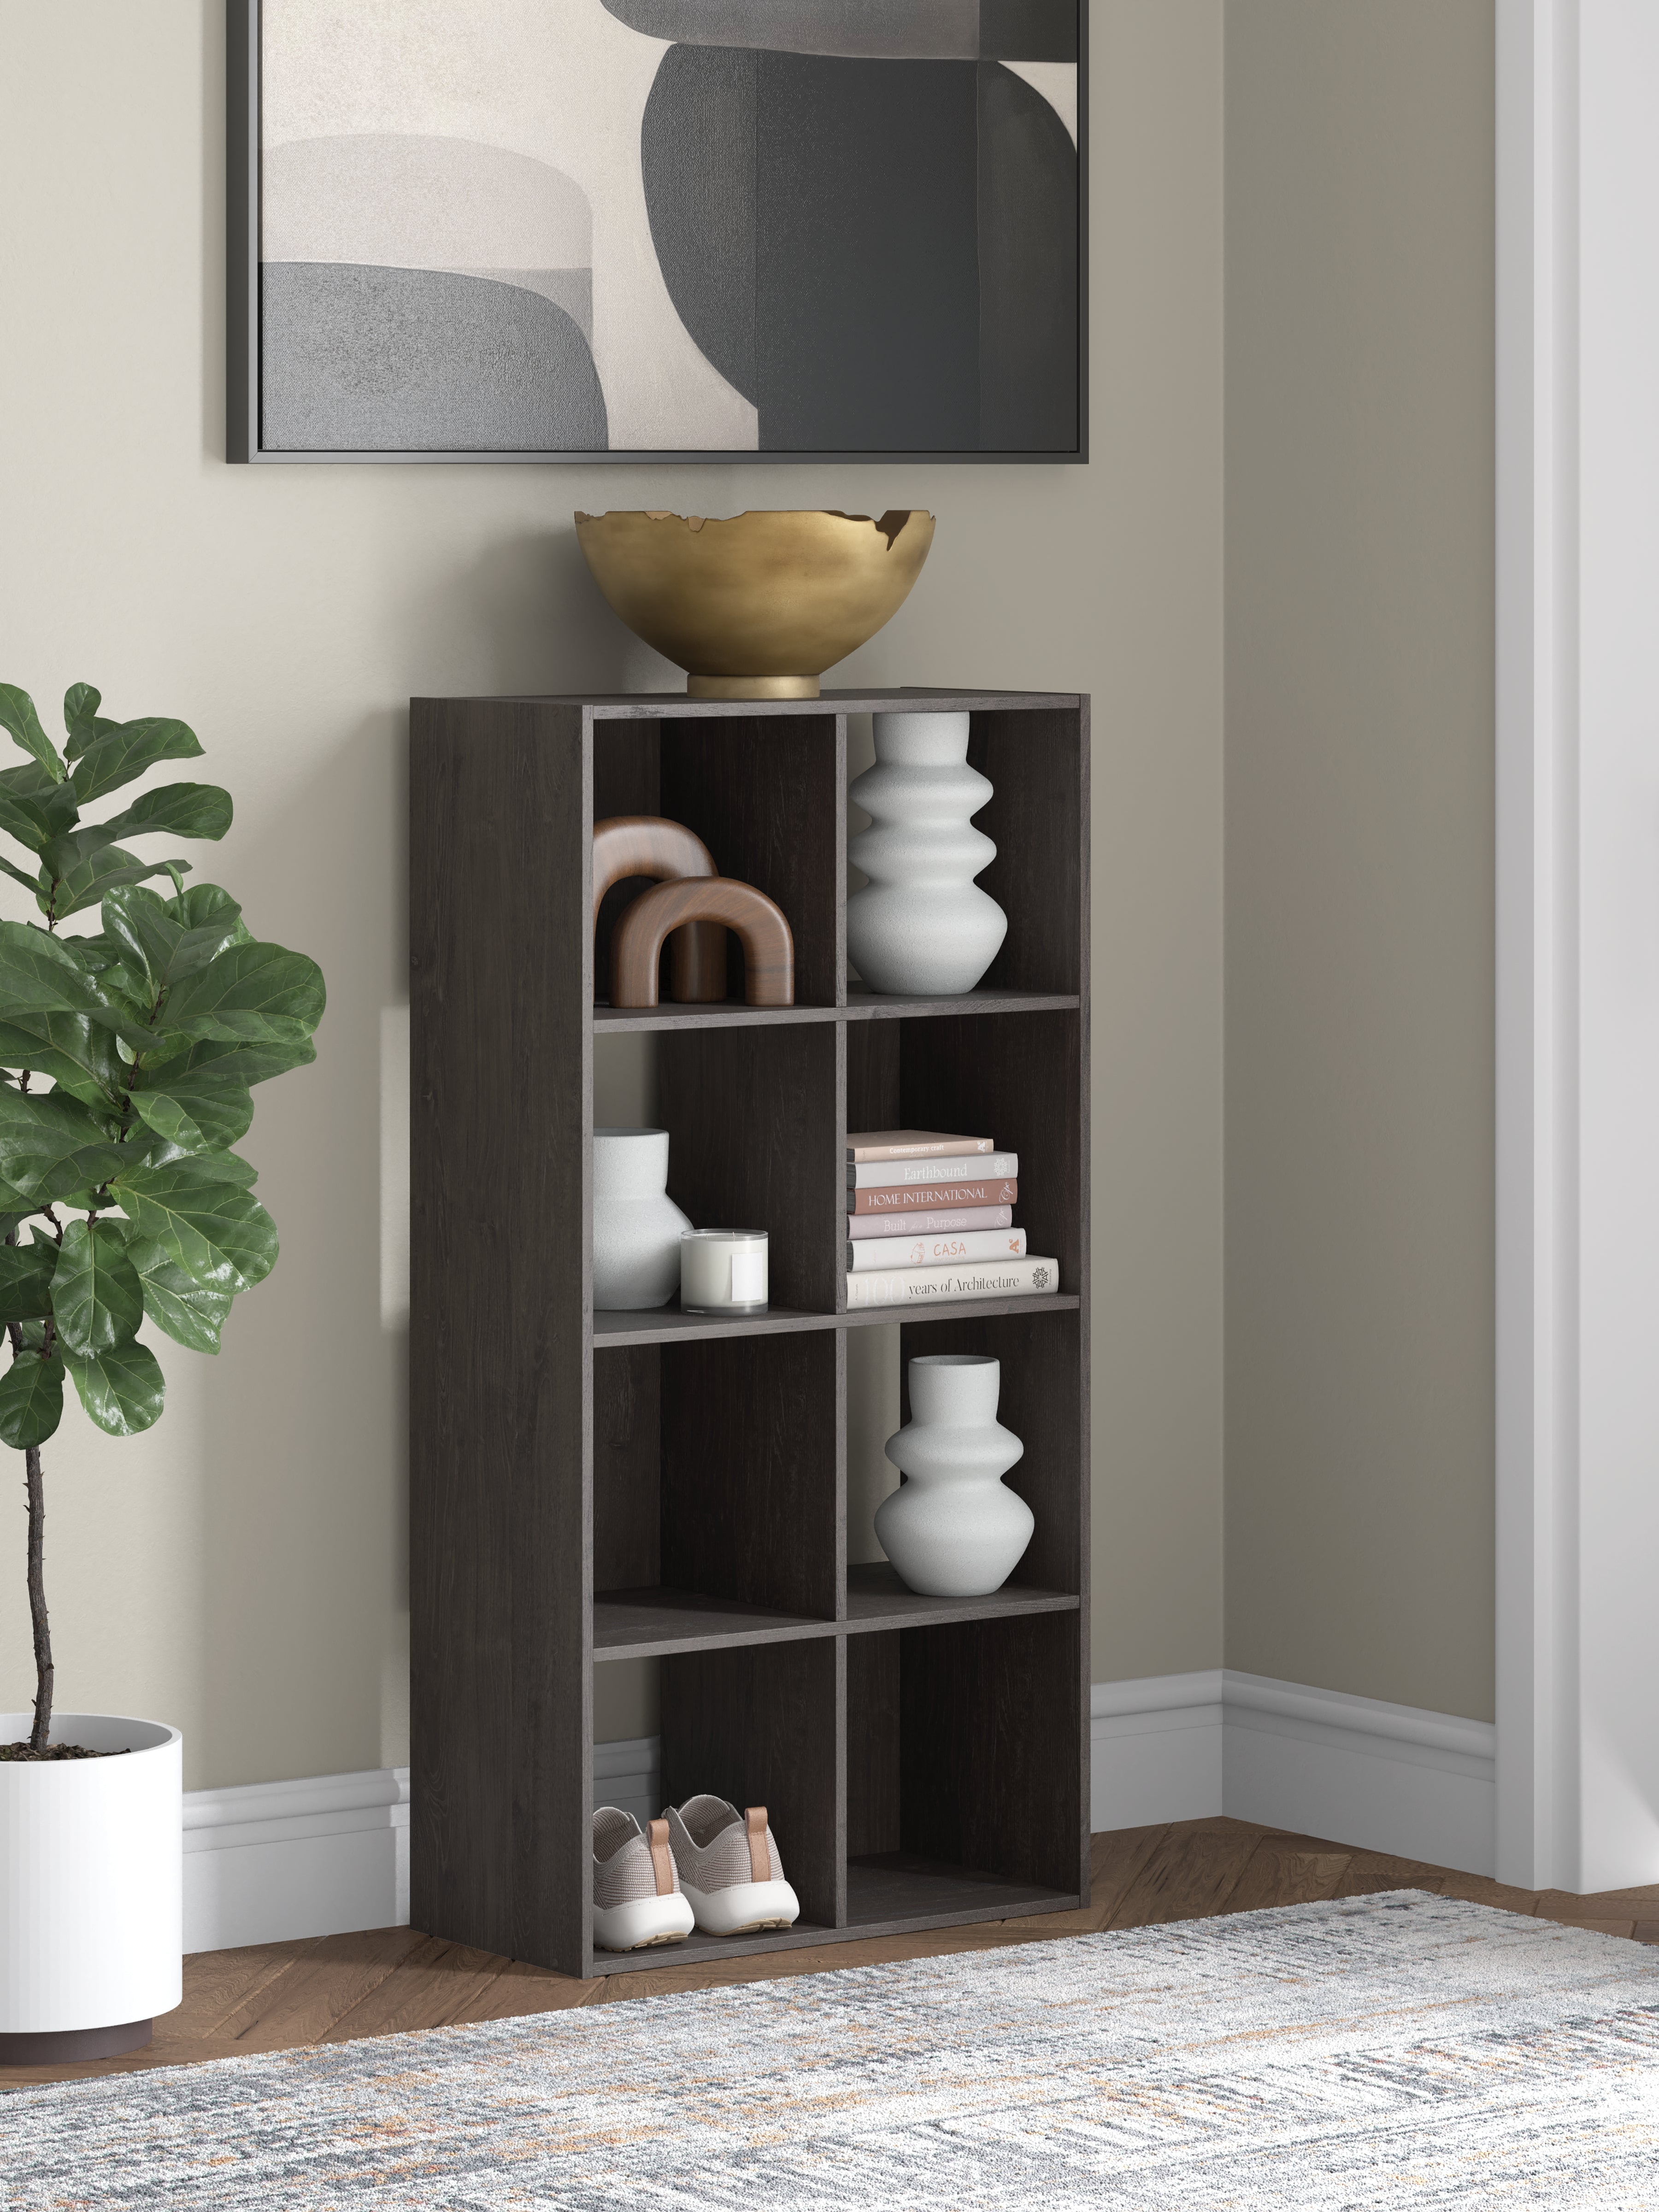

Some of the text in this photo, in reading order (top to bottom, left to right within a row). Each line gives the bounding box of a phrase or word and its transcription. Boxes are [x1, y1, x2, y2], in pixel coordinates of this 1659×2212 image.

[904, 1164, 968, 1181] Earthbound
[869, 1188, 988, 1206] HOME INTERNATIONAL
[884, 1219, 906, 1232] Built
[927, 1217, 967, 1230] Purpose
[933, 1241, 966, 1257] CASA
[864, 1275, 905, 1306] 100
[909, 1283, 937, 1299] years
[941, 1278, 952, 1293] of
[954, 1276, 1020, 1292] Architecture
